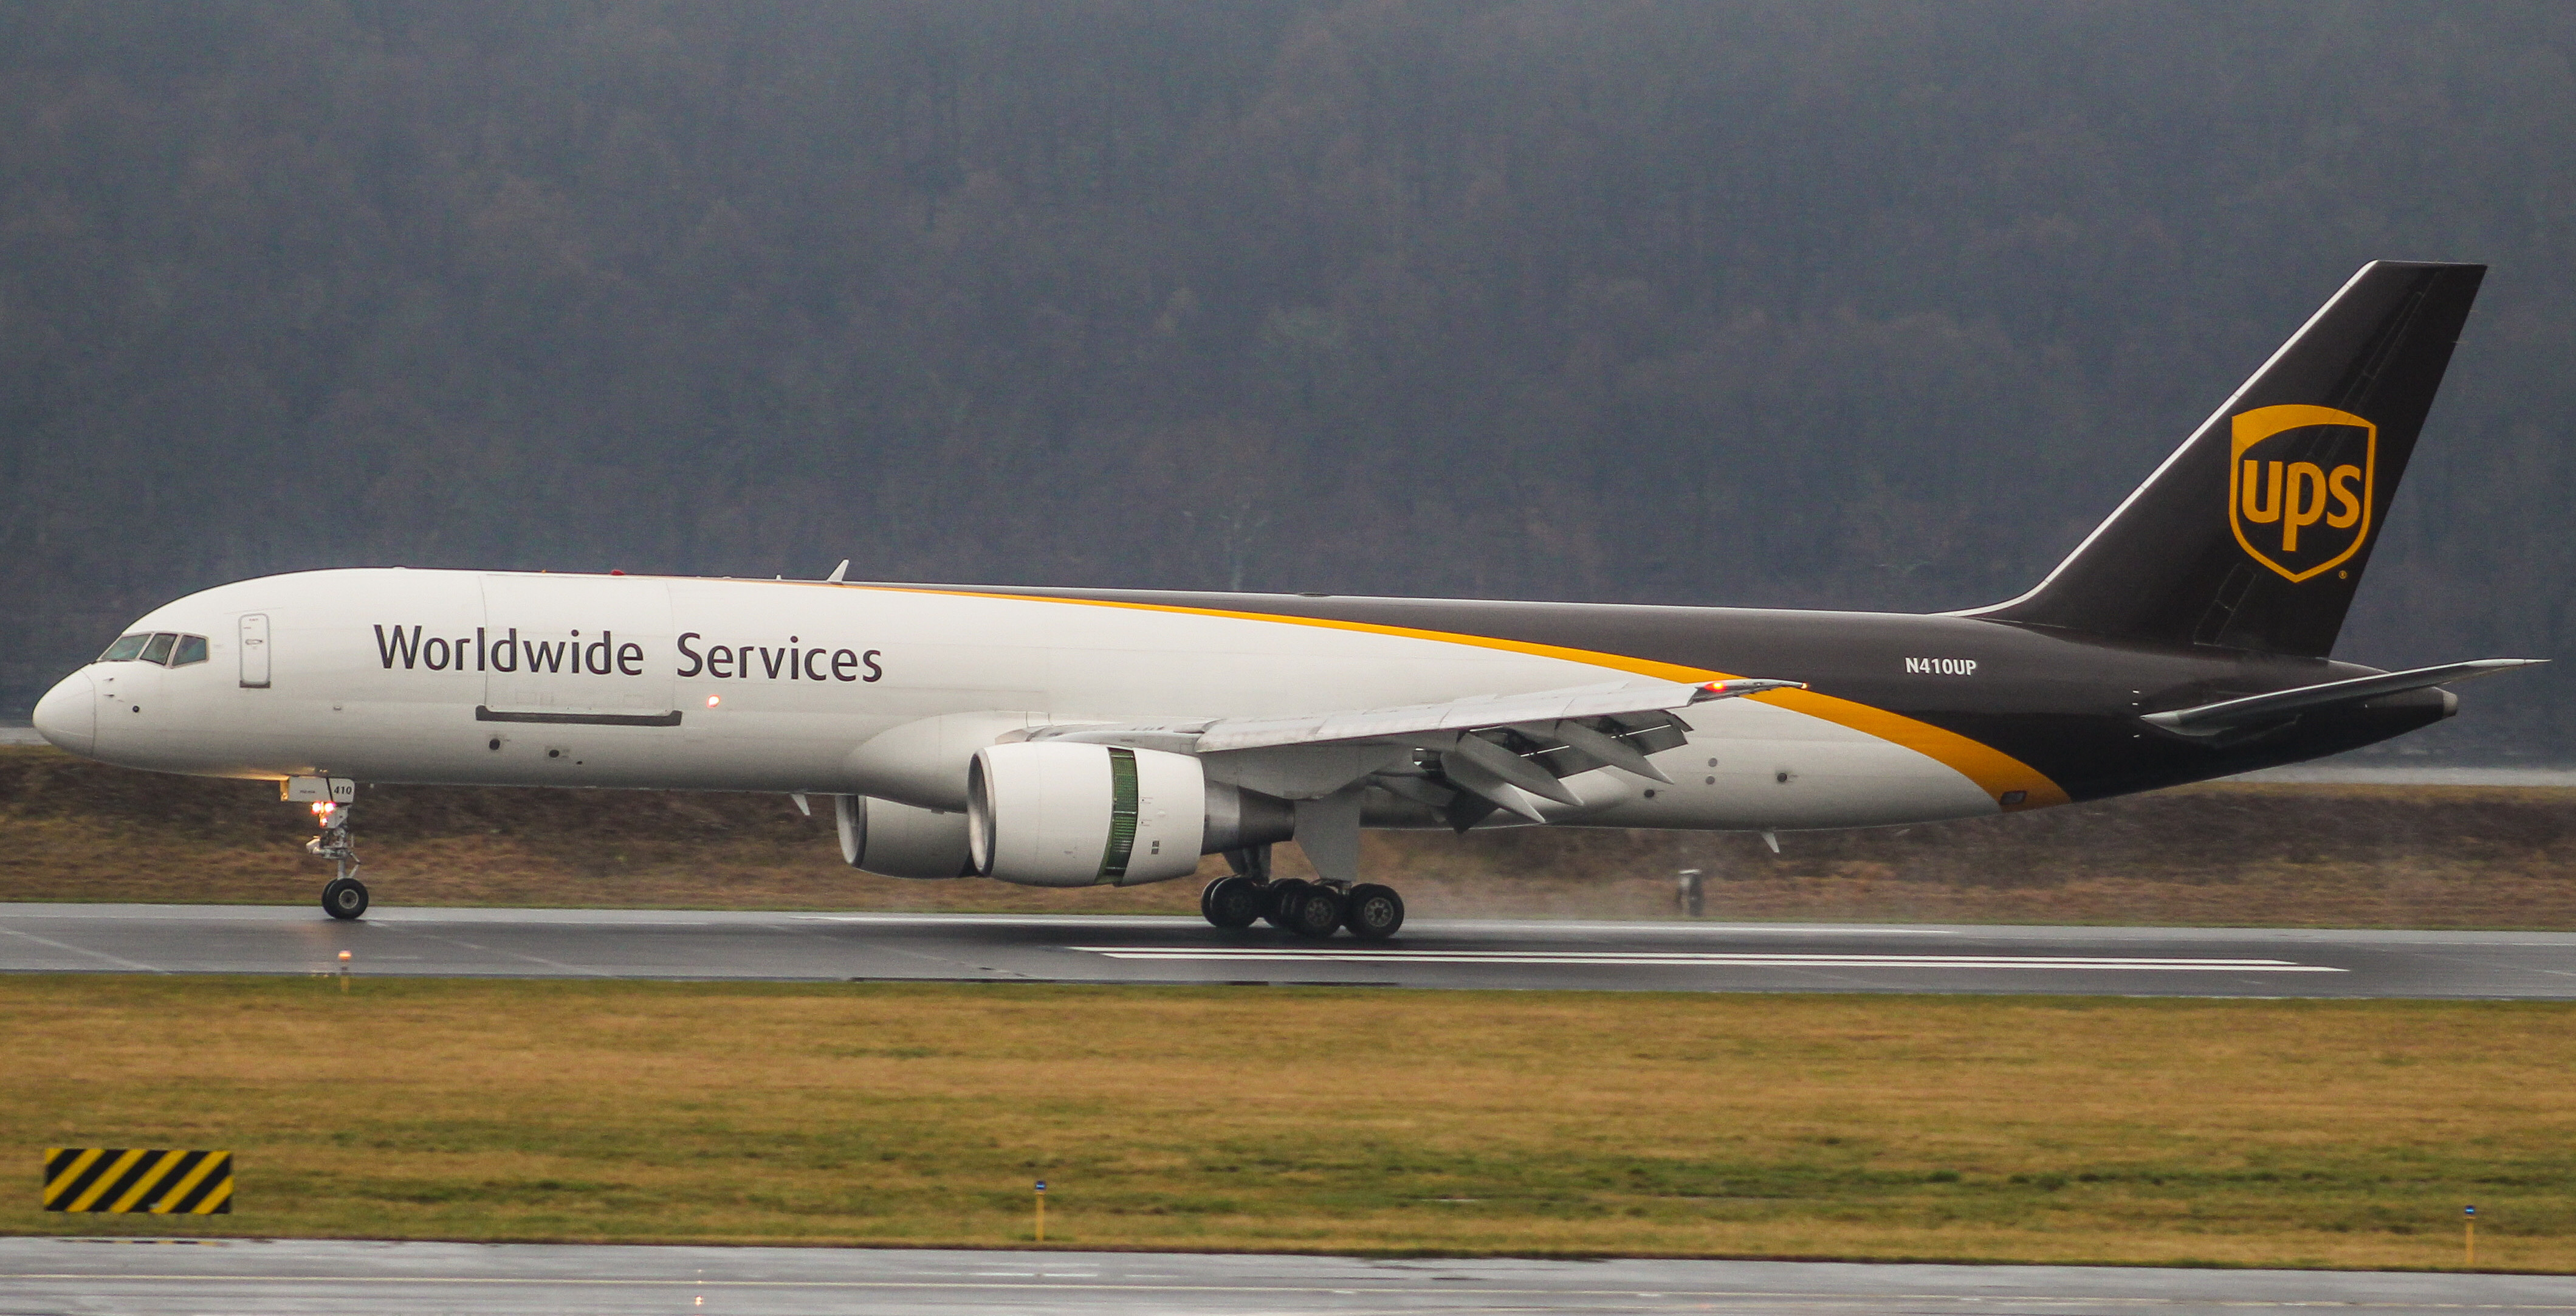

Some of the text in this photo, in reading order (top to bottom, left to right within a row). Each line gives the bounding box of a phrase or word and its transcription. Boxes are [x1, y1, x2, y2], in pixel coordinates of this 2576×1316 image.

[2242, 460, 2361, 551] ups
[374, 624, 884, 682] Worldwide Services
[1906, 657, 1976, 675] N410UP
[334, 786, 352, 794] 410
